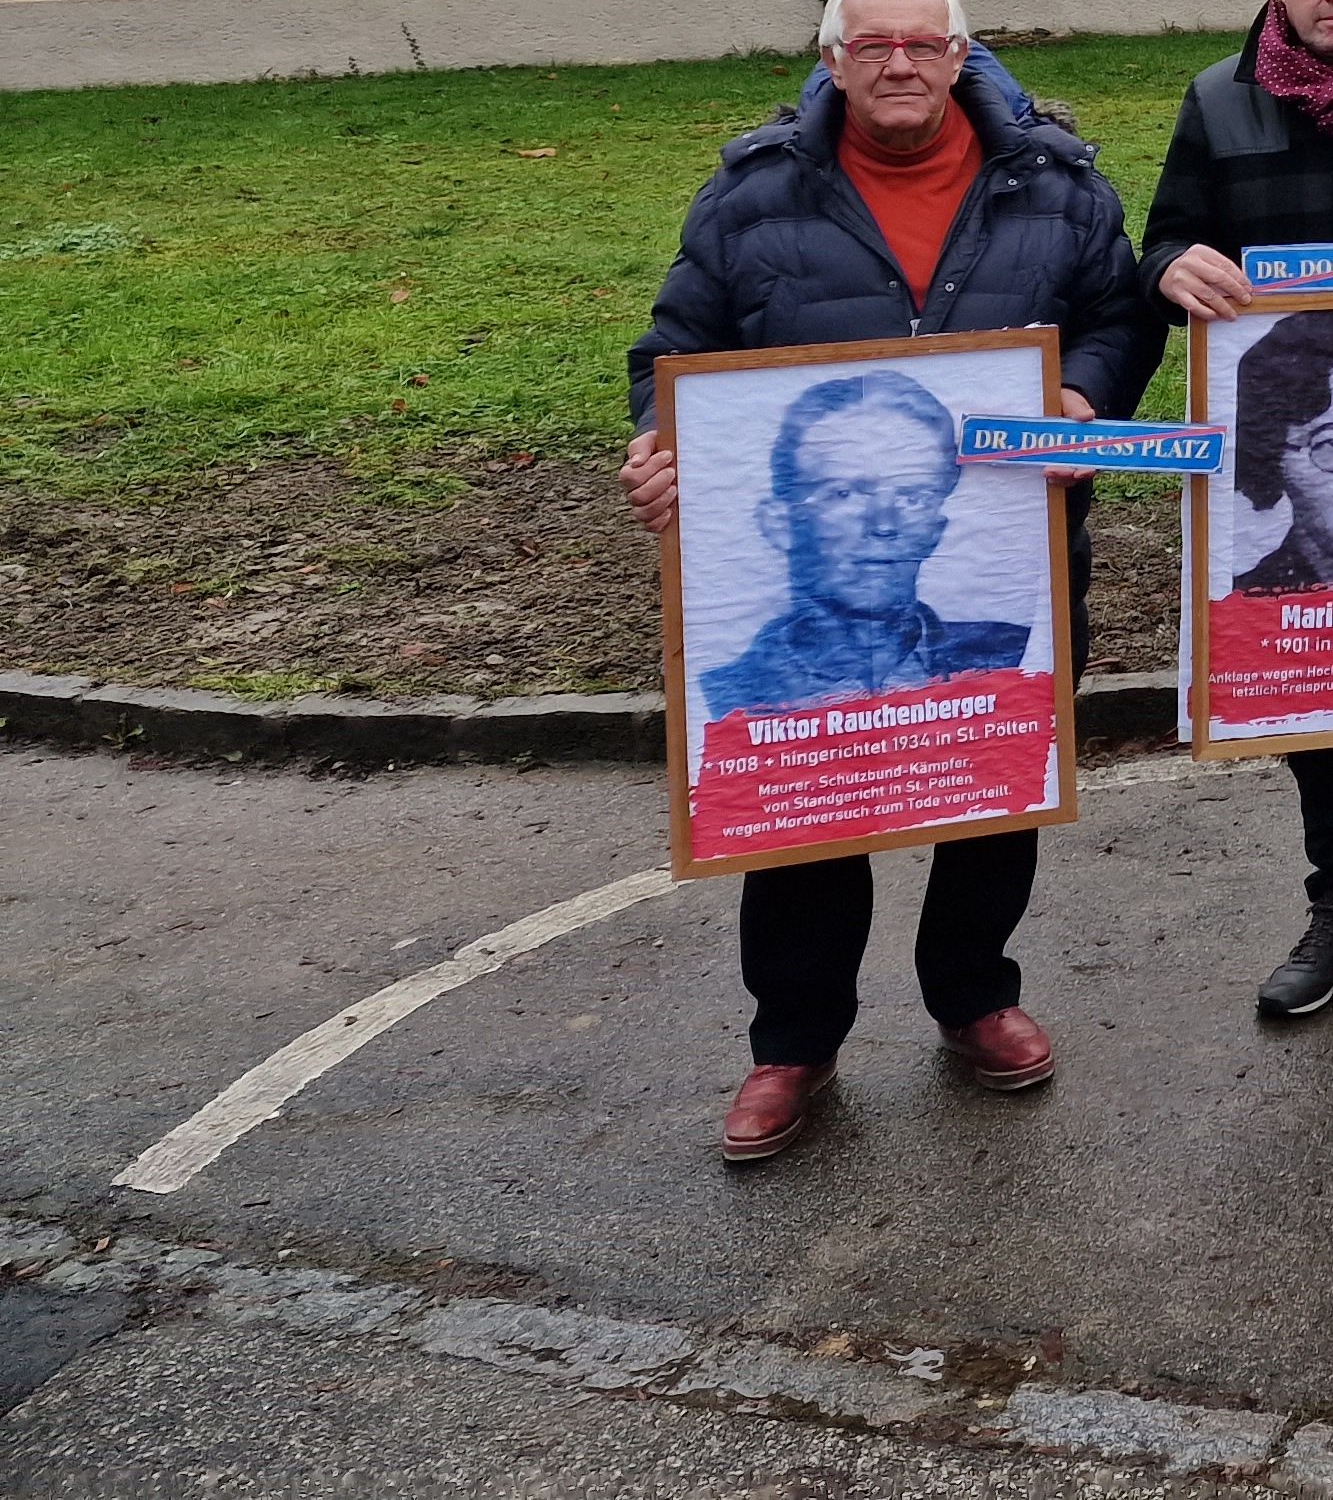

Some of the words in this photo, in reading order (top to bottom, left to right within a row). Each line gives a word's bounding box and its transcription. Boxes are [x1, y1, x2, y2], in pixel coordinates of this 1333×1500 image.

[1256, 260, 1294, 279] DR.
[974, 429, 1013, 450] DR.
[1021, 431, 1135, 456] DOLLFUSS
[1140, 438, 1209, 459] PLATZ
[1275, 637, 1309, 653] 1901
[1316, 637, 1330, 651] in
[1208, 671, 1258, 683] Anklage
[1262, 669, 1303, 681] wegen
[748, 718, 820, 745] Viktor
[827, 695, 995, 734] Rauchenberger
[718, 756, 758, 775] 1908
[781, 740, 887, 766] hingerichtet
[892, 733, 930, 751] 1934
[936, 731, 951, 746] in
[957, 727, 979, 742] St.
[985, 721, 1038, 738] Pölten
[759, 781, 814, 796] Maurer,
[819, 758, 972, 788] Schutzbund-Kämpfer,
[763, 801, 789, 813] von
[794, 786, 884, 809] Standgericht
[889, 784, 902, 795] in
[905, 780, 924, 793] St.
[929, 775, 973, 789] Pölten
[723, 822, 770, 837] wegen
[775, 806, 869, 829] Mordversuch
[873, 802, 903, 815] zum
[907, 796, 940, 810] Tode
[945, 785, 1011, 805] verurteilt.
